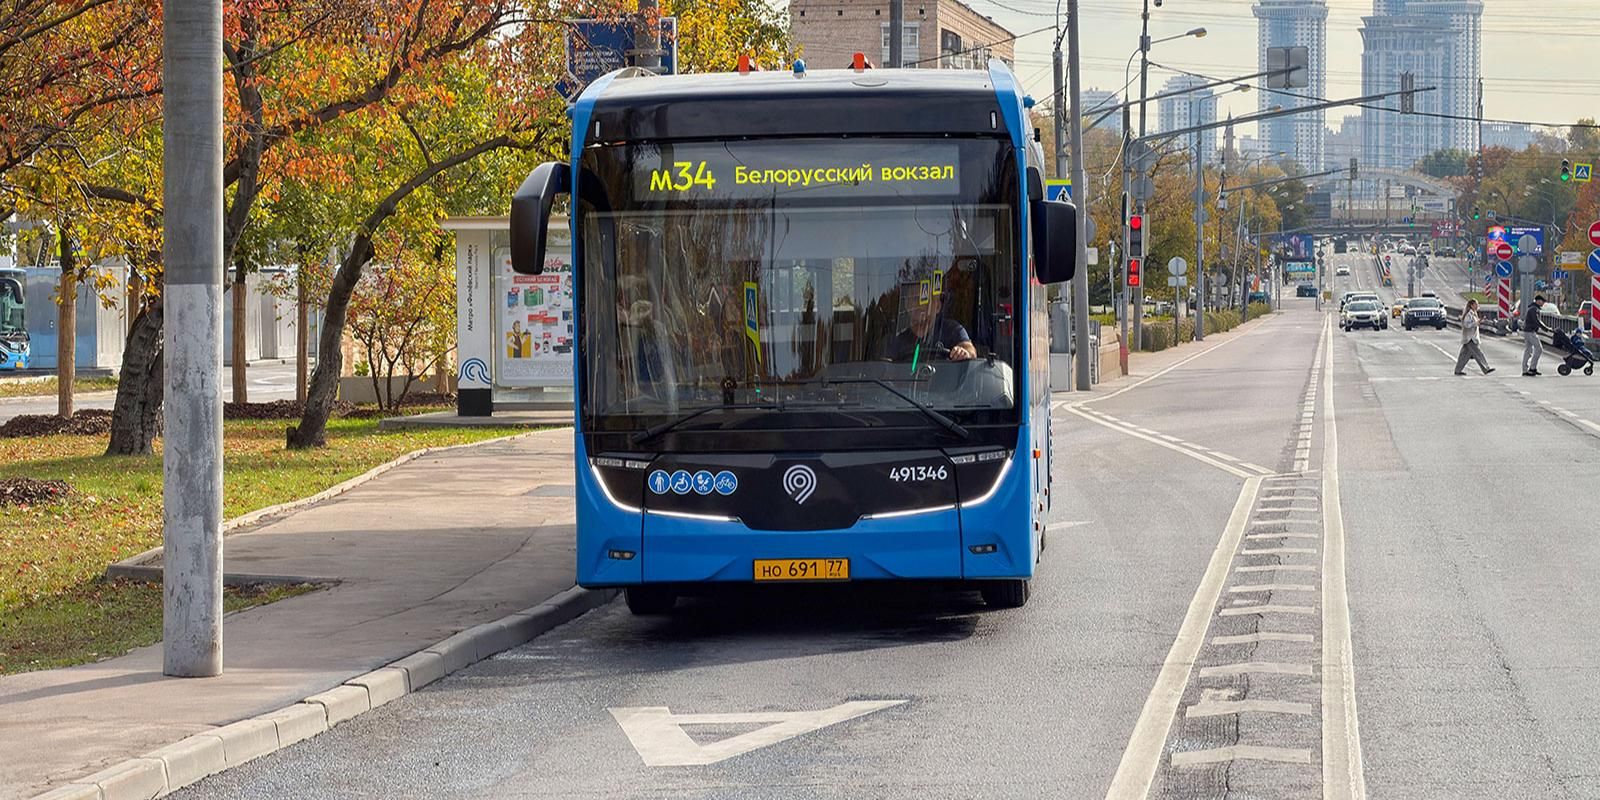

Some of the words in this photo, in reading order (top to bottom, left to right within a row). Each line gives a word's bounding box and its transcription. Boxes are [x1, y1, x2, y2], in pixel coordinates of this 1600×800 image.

[735, 164, 873, 185] Белорусский
[881, 164, 954, 181] вокзал
[889, 465, 948, 482] 491346
[788, 561, 818, 577] 691
[827, 560, 843, 573] 77
